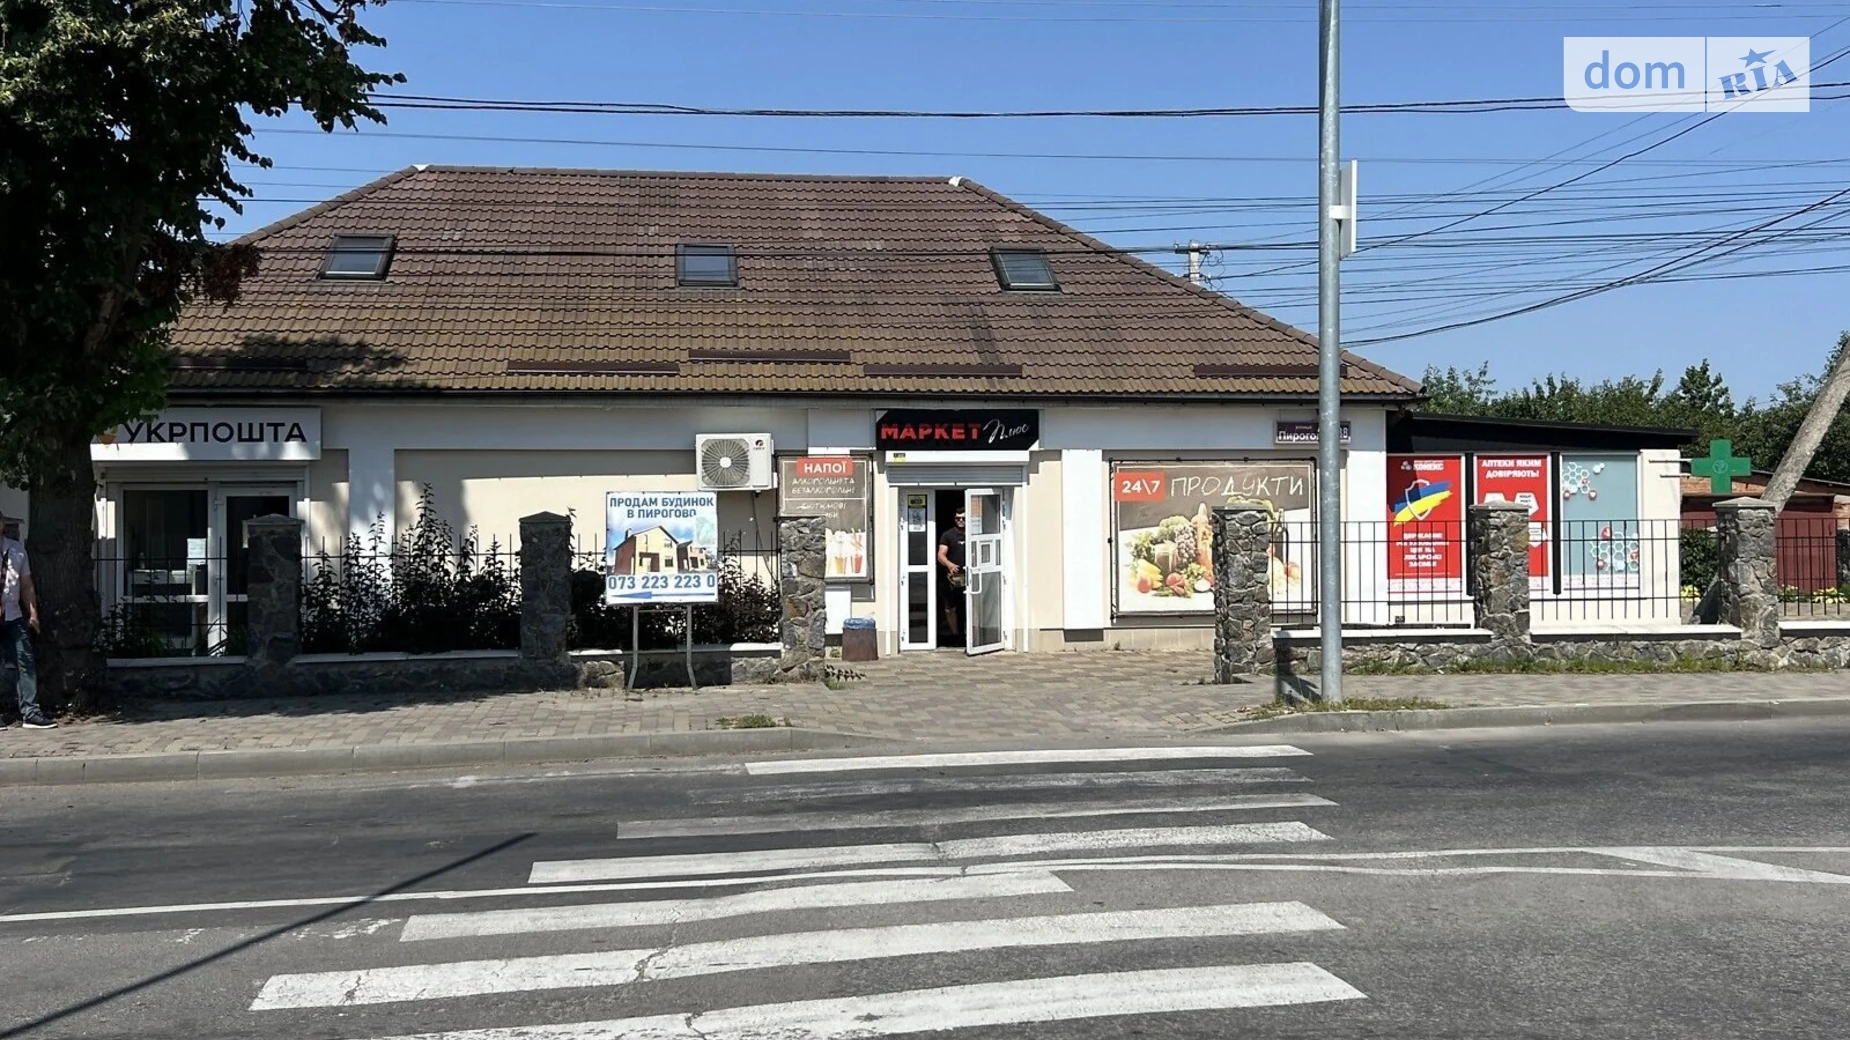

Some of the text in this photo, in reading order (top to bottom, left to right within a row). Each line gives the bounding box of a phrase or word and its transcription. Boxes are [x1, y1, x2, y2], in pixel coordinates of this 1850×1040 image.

[124, 422, 307, 443] УКРПОШТА
[881, 423, 981, 440] МАРКЕТ
[1278, 430, 1320, 443] Пирого
[804, 461, 847, 474] НАПОЇ
[1171, 476, 1304, 497] ПРОДУКТИ
[610, 497, 714, 508] ПРОДАМ БУДИНОК
[627, 508, 696, 519] В ПИРОГОВО
[608, 574, 715, 590] 073 223 223 0
